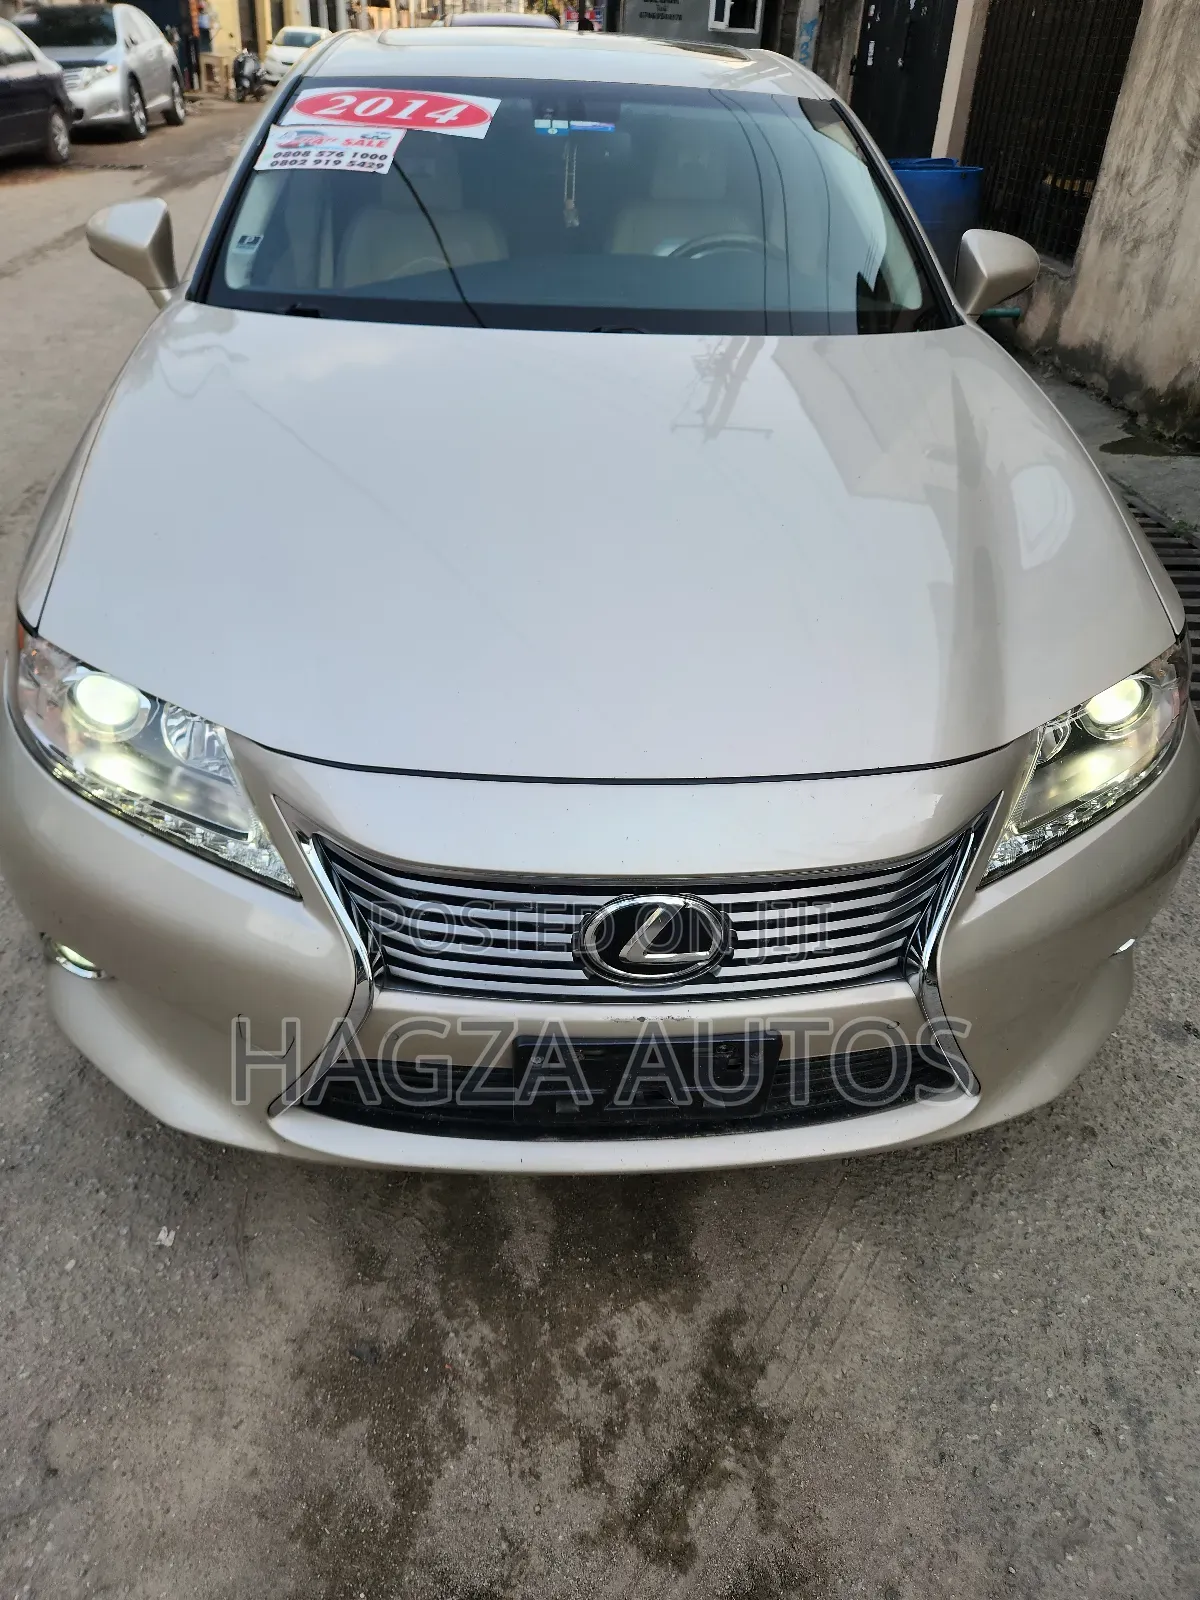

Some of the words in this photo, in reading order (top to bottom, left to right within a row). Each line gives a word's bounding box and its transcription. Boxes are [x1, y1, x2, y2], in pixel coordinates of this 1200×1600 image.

[312, 94, 470, 124] 2014
[315, 150, 345, 158] 576
[351, 152, 388, 161] 1000
[270, 159, 308, 167] 0802
[313, 159, 342, 167] 919
